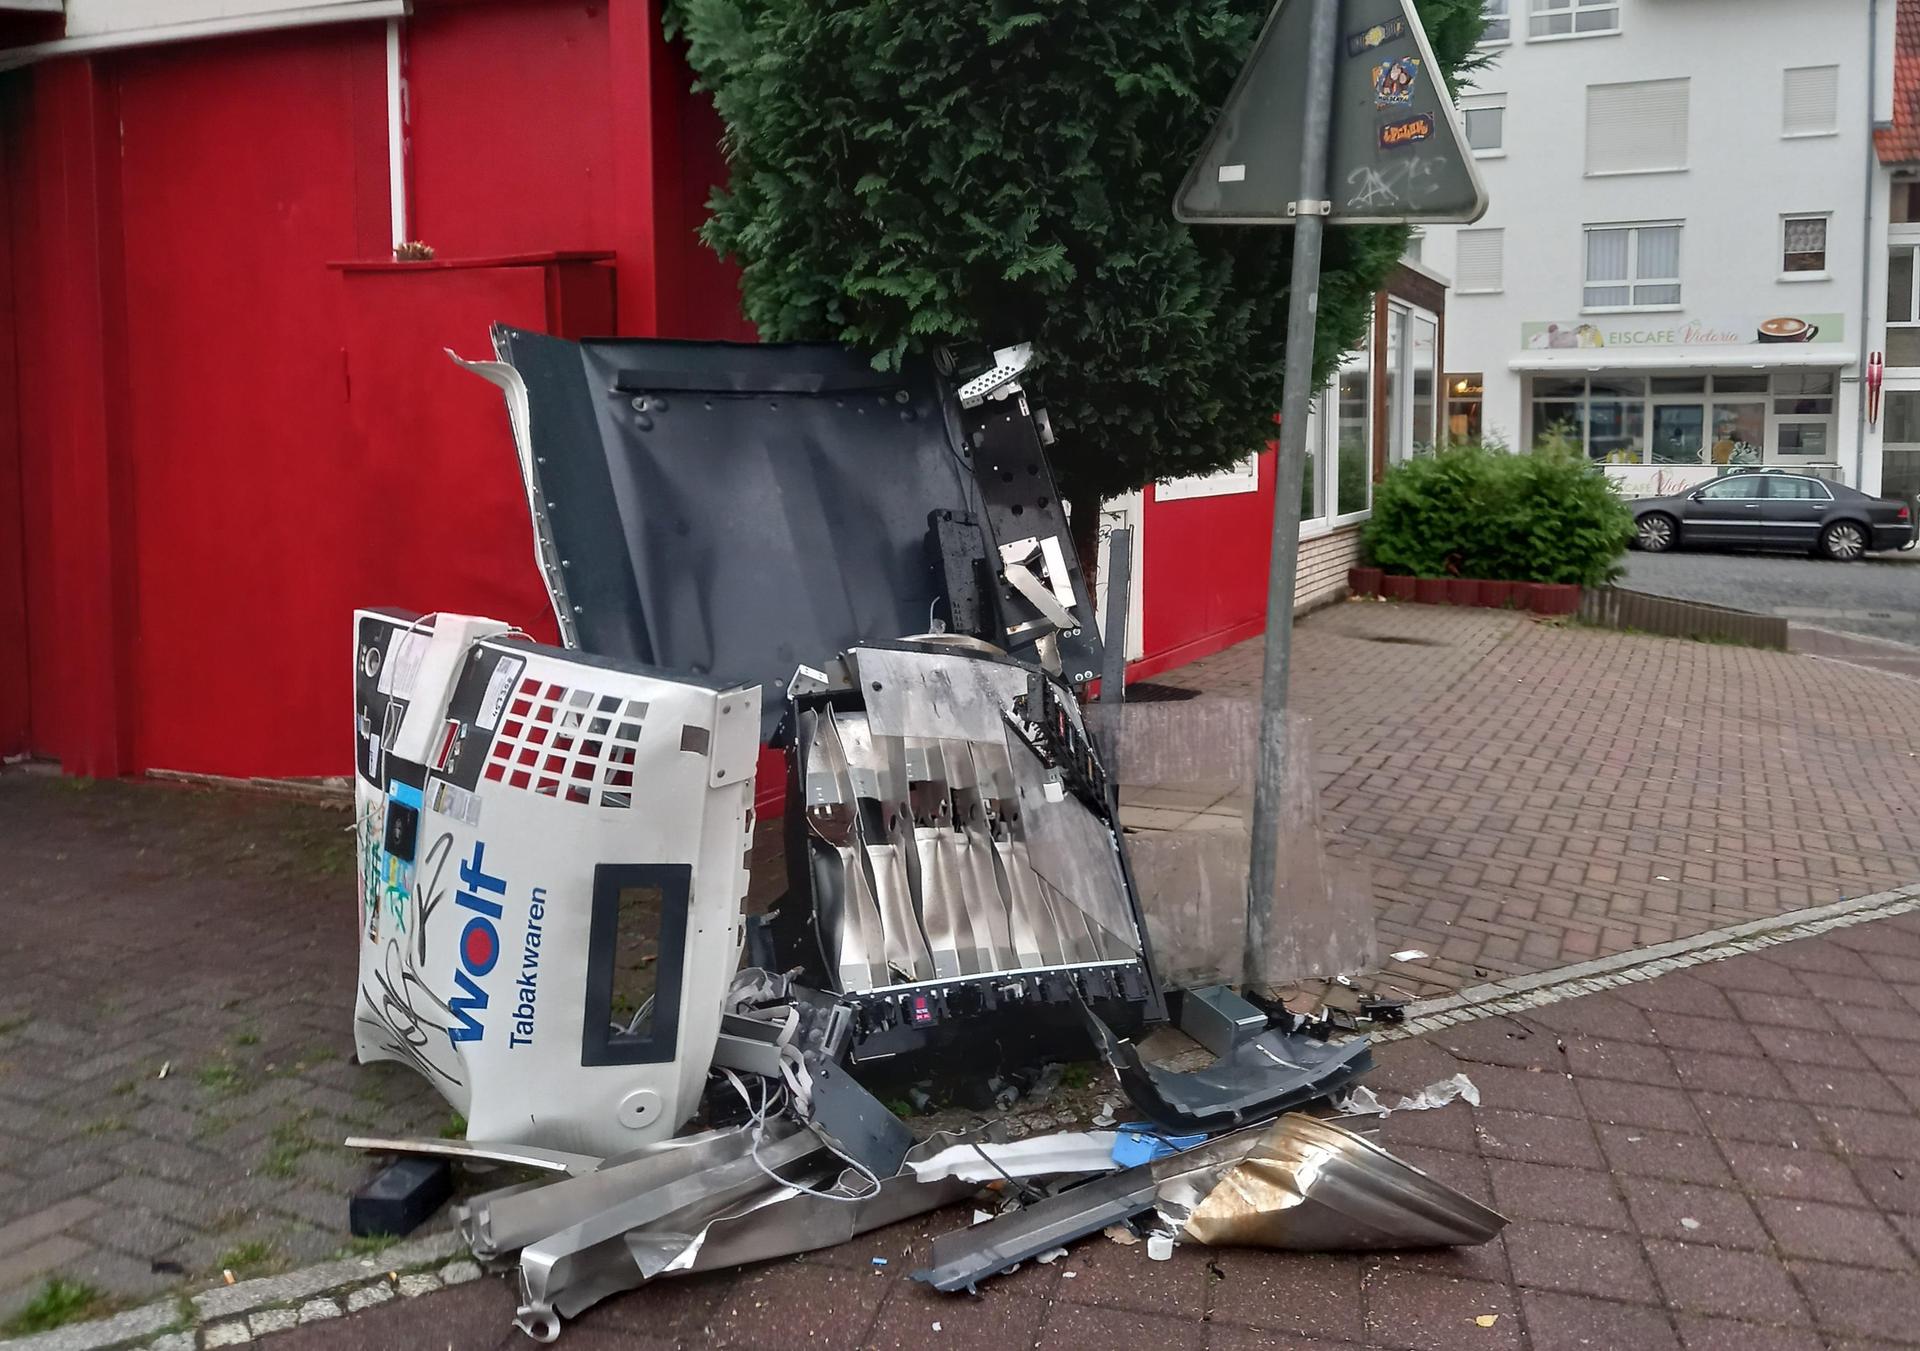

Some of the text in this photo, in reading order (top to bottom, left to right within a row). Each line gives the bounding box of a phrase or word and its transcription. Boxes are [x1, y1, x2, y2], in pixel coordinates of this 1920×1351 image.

[1681, 323, 1738, 344] Victoria
[447, 840, 507, 1042] wolf
[509, 887, 547, 1049] Tabakwaren
